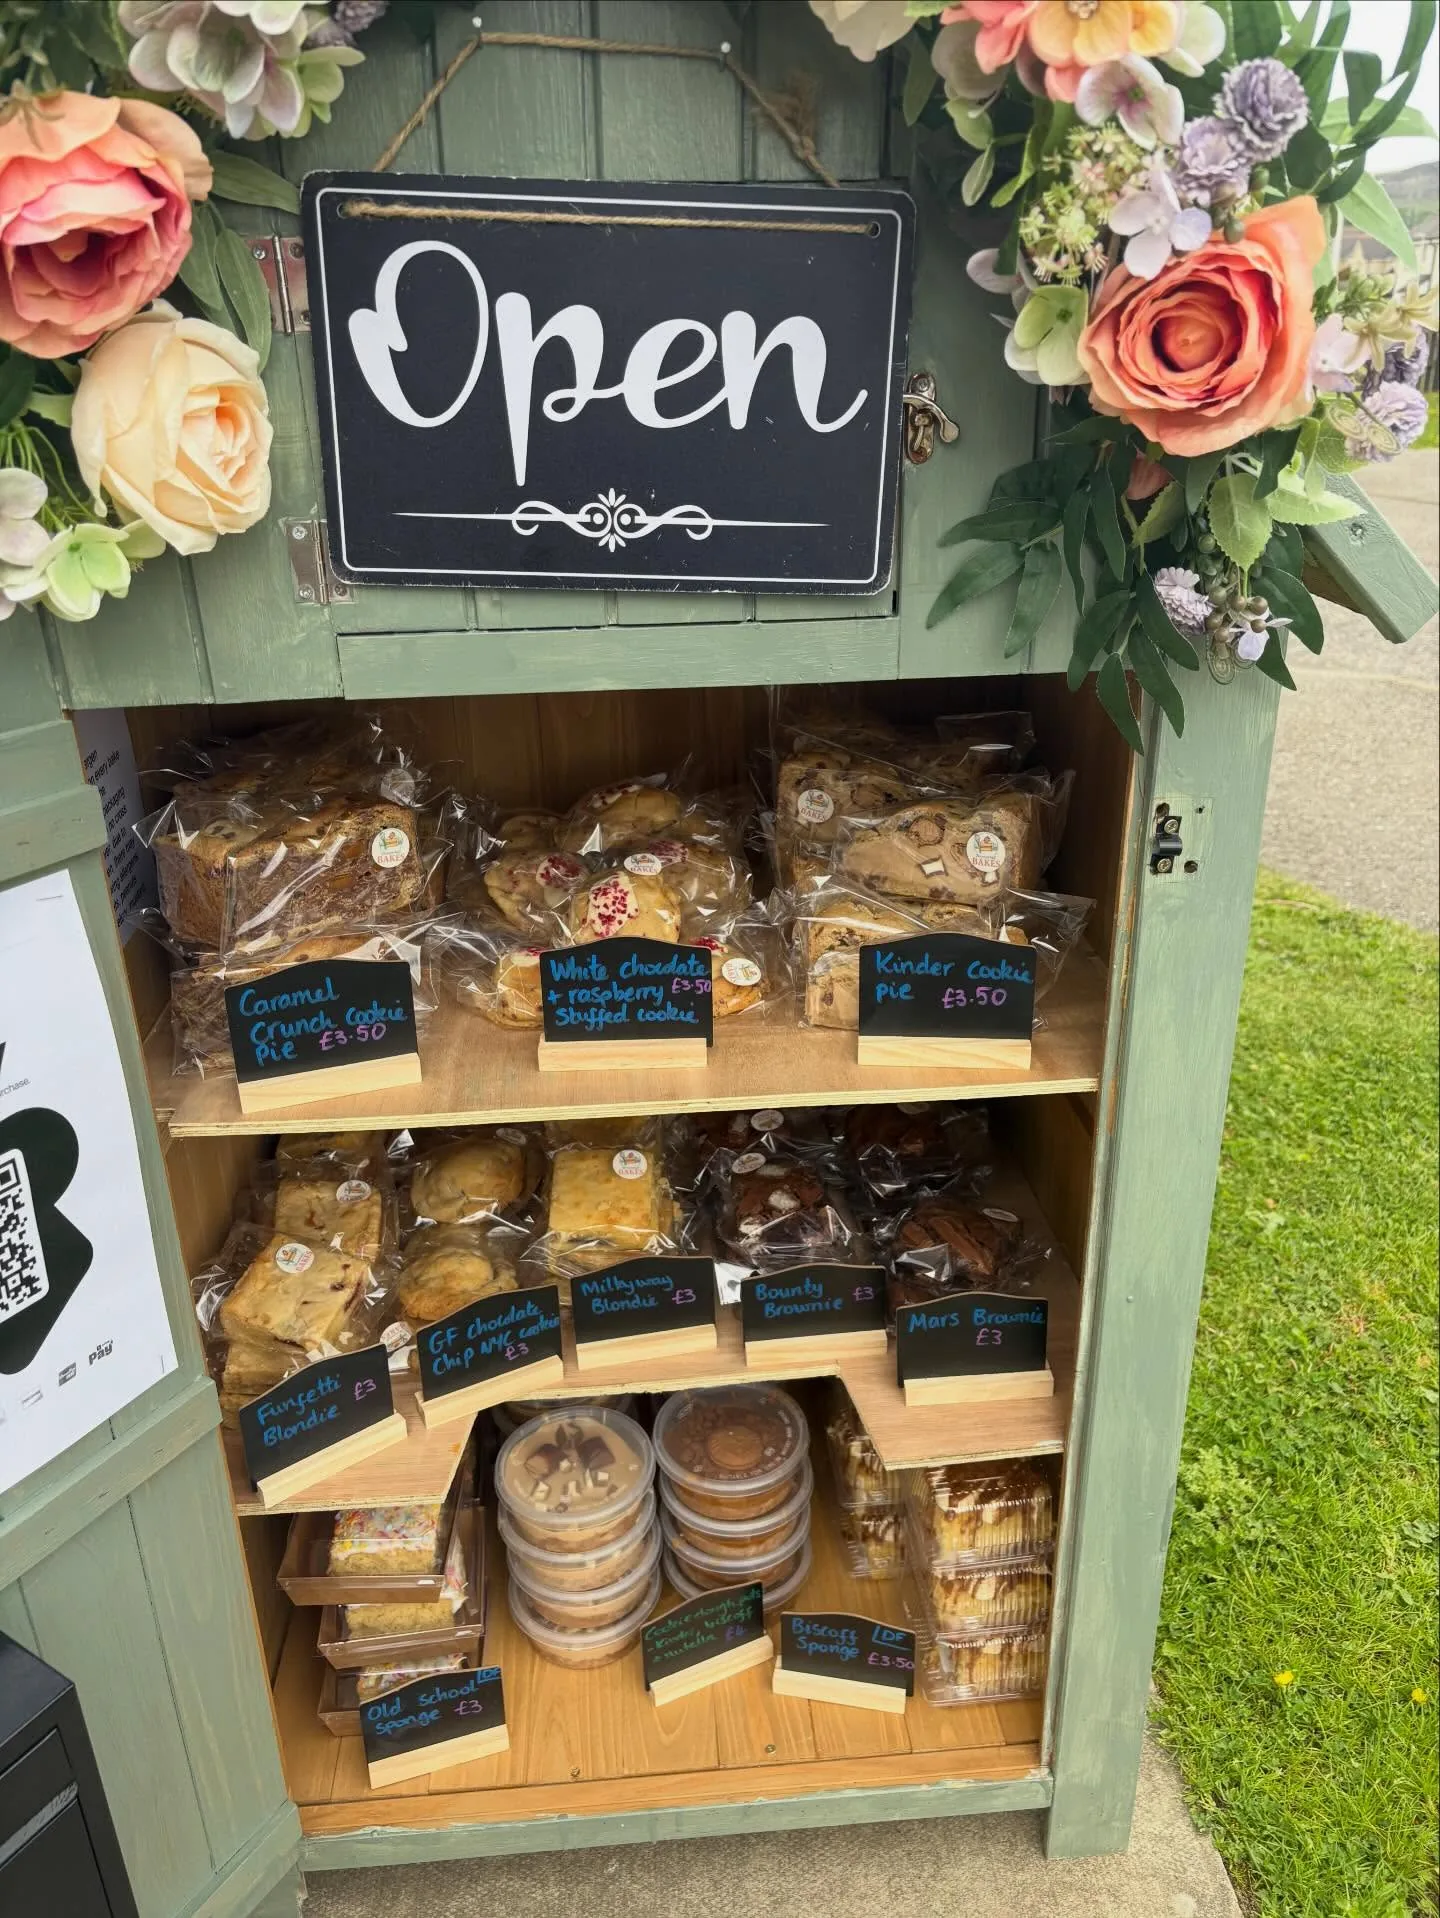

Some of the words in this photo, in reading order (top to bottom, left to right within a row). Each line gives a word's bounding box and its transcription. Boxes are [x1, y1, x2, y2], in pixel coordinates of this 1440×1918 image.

[348, 240, 869, 487] Open
[972, 857, 1001, 867] BAKES
[550, 953, 609, 982] White
[875, 950, 955, 978] Kinder
[239, 976, 340, 1017] Caramel
[548, 989, 562, 1005] +
[568, 981, 664, 1009] raspberry
[671, 977, 712, 994] £3.50
[942, 986, 1007, 1009] £3.50
[319, 1022, 387, 1051] £3.50
[0, 1078, 31, 1096] rchase.
[591, 1294, 658, 1314] Blondie
[672, 1288, 697, 1305] £3
[755, 1277, 823, 1301] Bounty
[852, 1286, 875, 1301] £3
[764, 1298, 844, 1318] Brownie
[909, 1312, 960, 1332] Mars
[973, 1305, 1046, 1325] Brownie
[429, 1326, 459, 1355] GF
[975, 1328, 1003, 1346] £3
[505, 1343, 530, 1361] £3
[257, 1374, 342, 1426] Funfetti
[355, 1379, 377, 1401] £3
[263, 1405, 341, 1447] Blondie
[791, 1617, 859, 1645] Biscoff
[872, 1625, 906, 1643] LDF
[868, 1652, 916, 1670] £3.50
[367, 1697, 401, 1721] Old
[453, 1699, 483, 1715] £3
